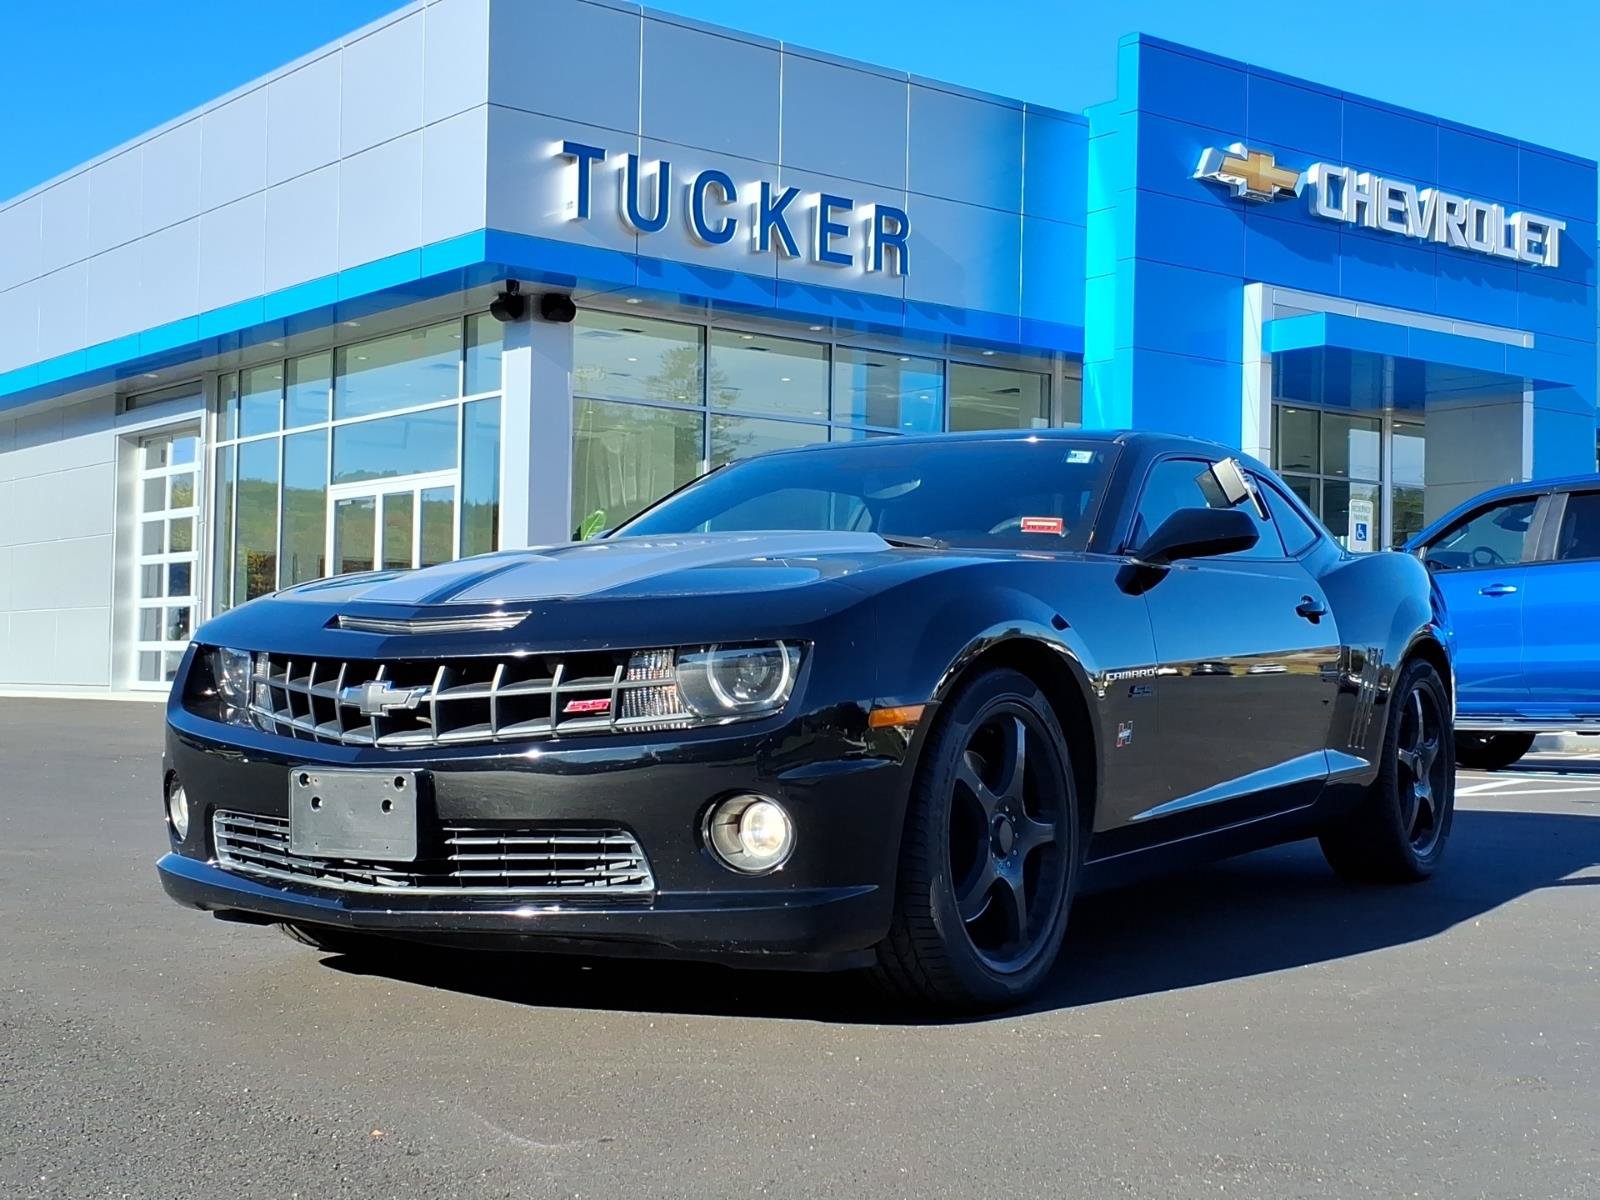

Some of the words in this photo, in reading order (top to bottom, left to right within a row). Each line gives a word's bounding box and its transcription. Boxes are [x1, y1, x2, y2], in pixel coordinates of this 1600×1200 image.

[556, 140, 911, 276] TUCKER
[1307, 162, 1566, 268] CHEVROLET
[1106, 668, 1155, 681] CAMARO
